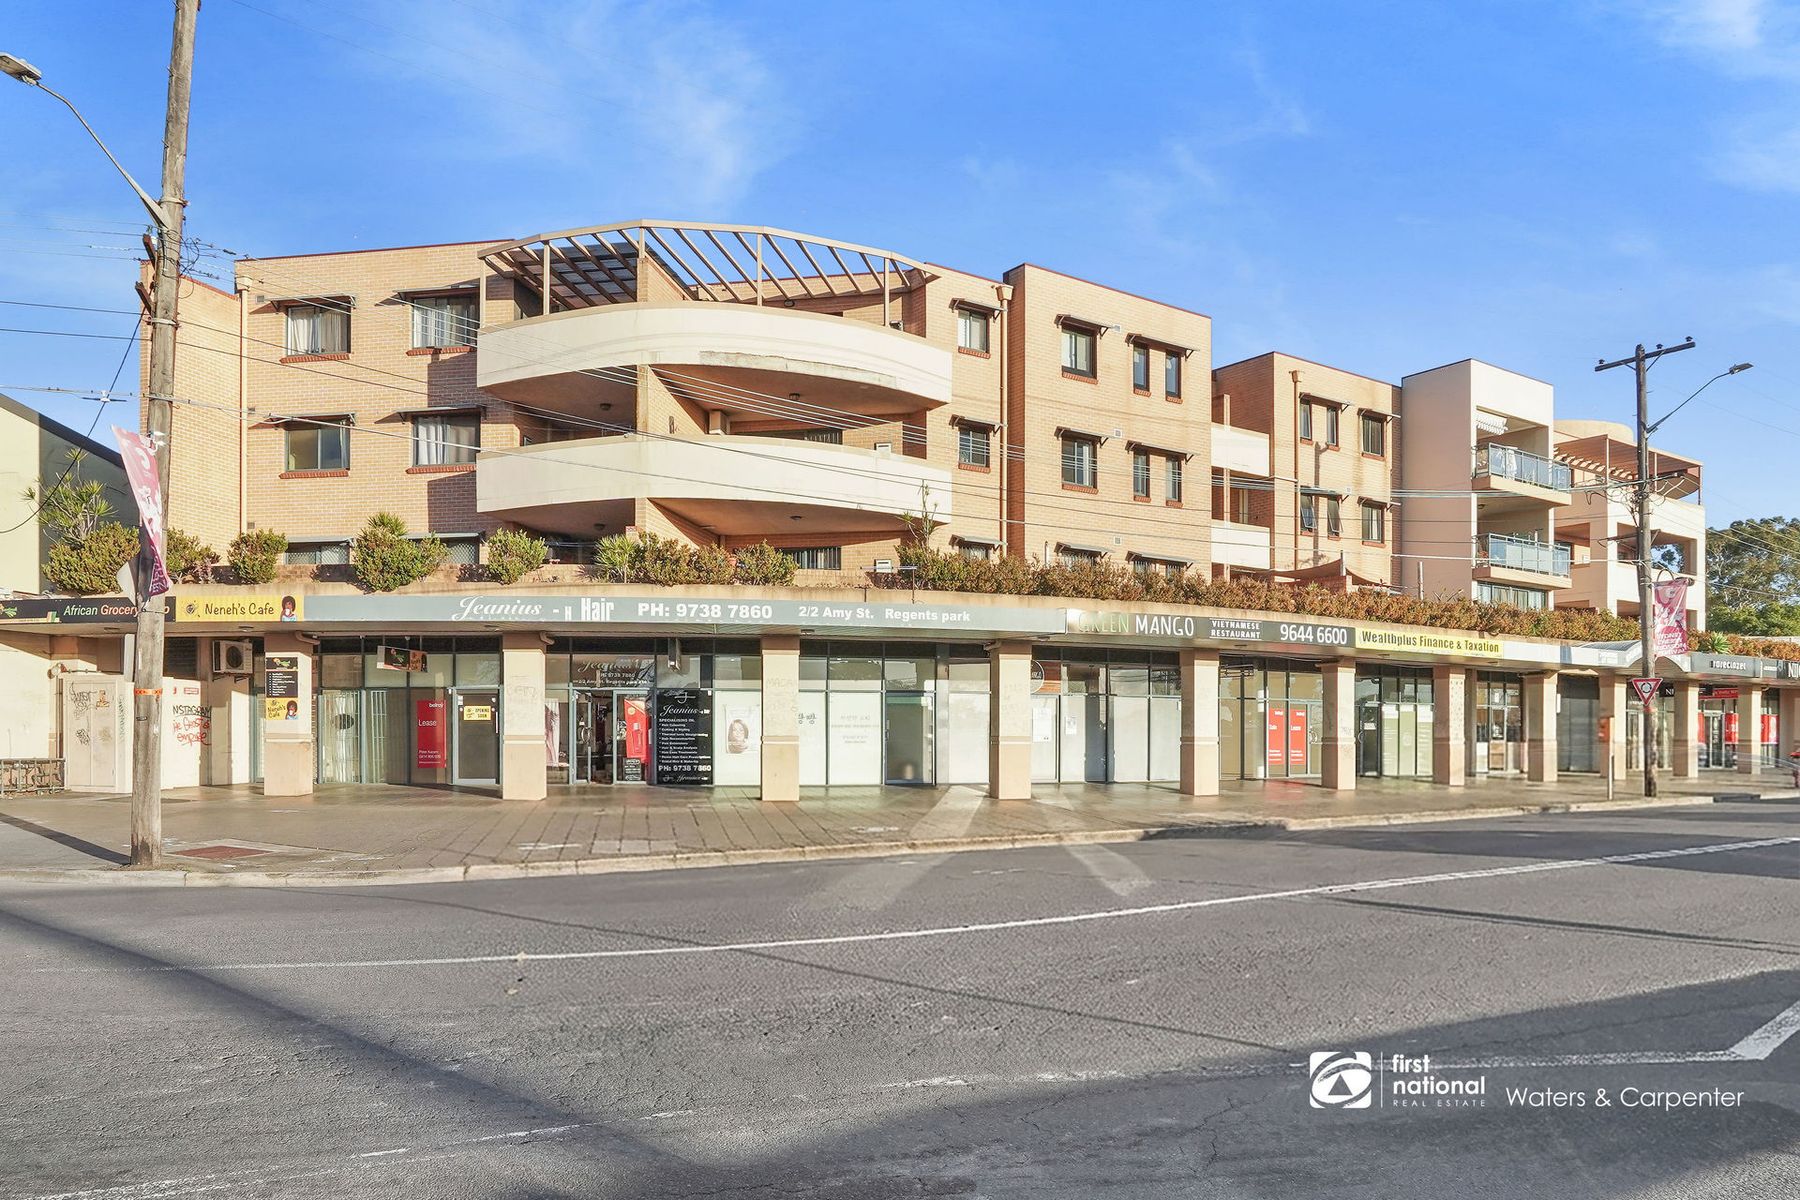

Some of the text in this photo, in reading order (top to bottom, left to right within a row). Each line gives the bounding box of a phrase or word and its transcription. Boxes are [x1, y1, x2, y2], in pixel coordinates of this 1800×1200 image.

[63, 604, 139, 618] African Grocery
[204, 602, 274, 615] Neneh's Cafe
[451, 596, 542, 621] Jeanius
[580, 597, 615, 621] Hair
[637, 602, 773, 619] PH: 9738 7860
[798, 606, 971, 623] 2/2 Amy St. Regents park
[1135, 614, 1194, 636] MANGO
[1211, 620, 1260, 630] VIETNAMESE
[1211, 629, 1261, 639] RESTAURANT
[1280, 623, 1347, 645] 9644 6600
[1362, 630, 1499, 653] Wealthplus Finance & Taxation
[418, 719, 437, 727] Lease
